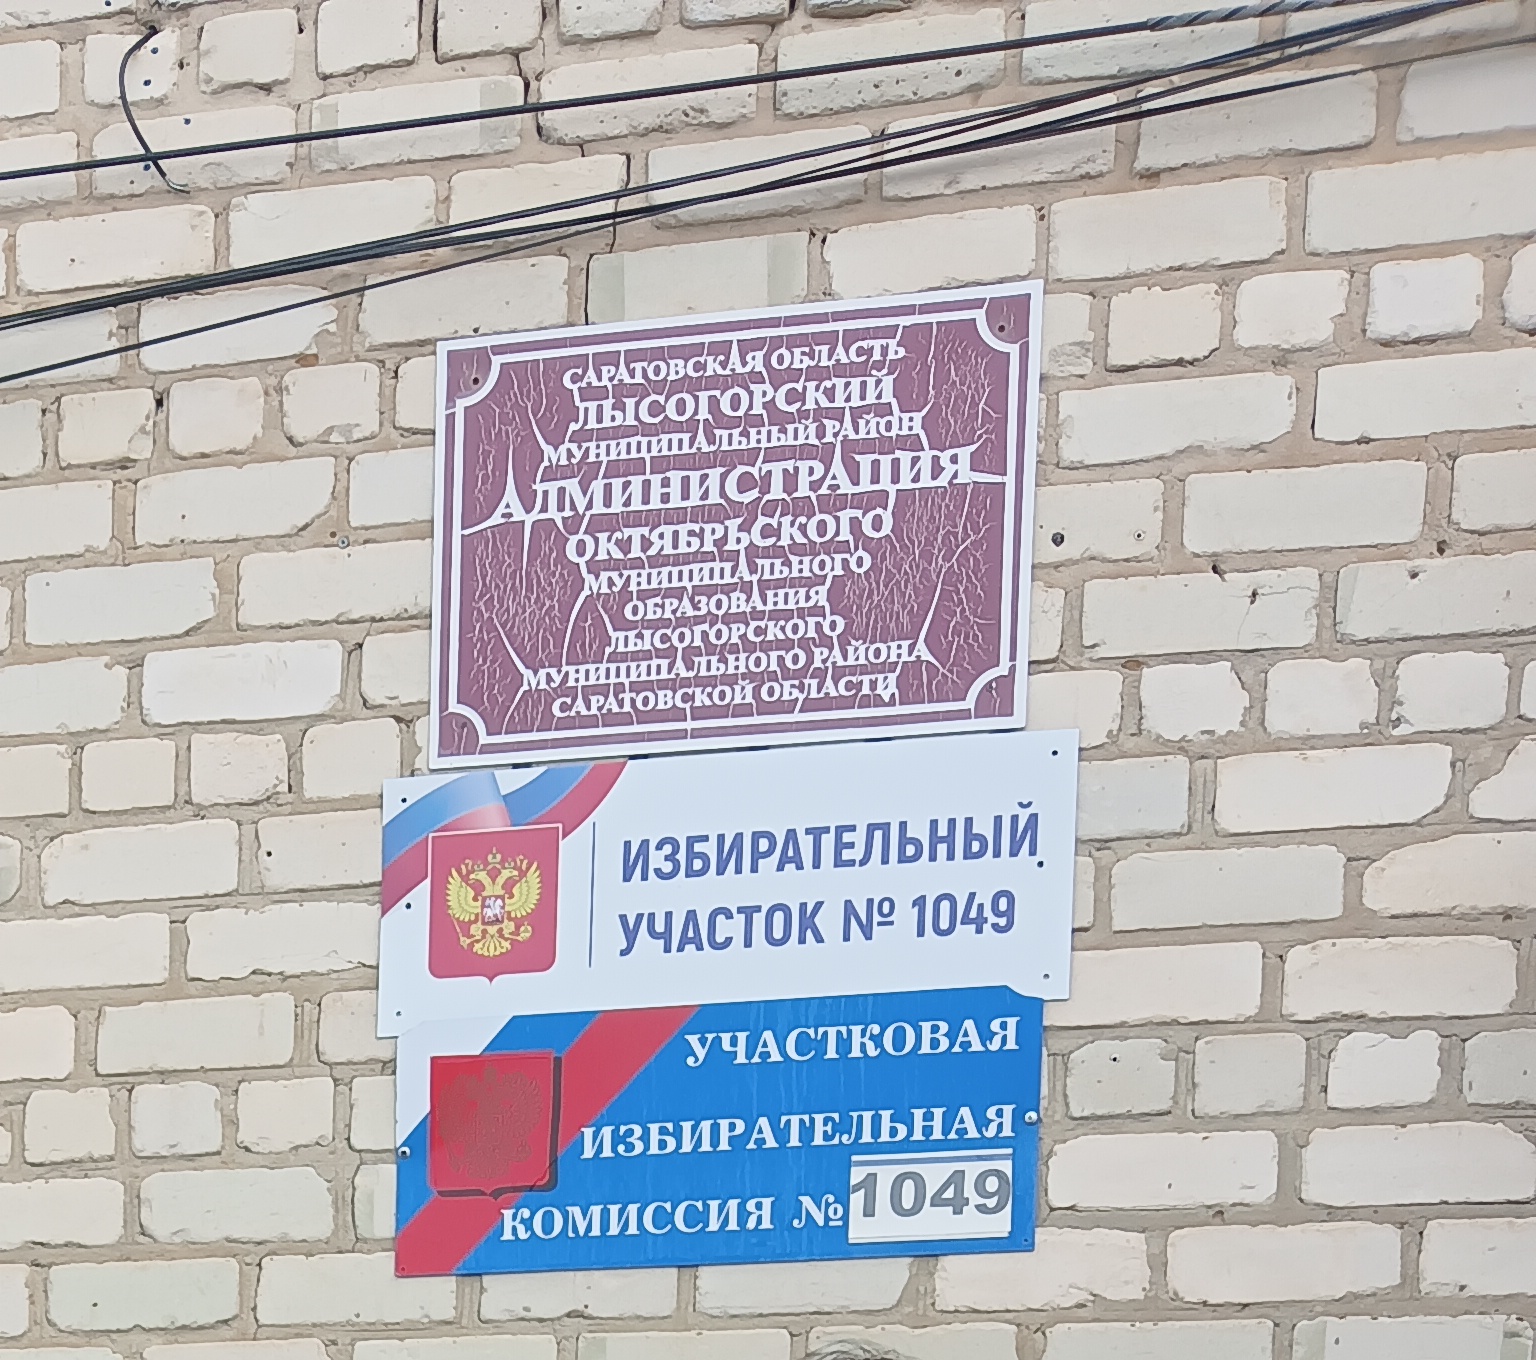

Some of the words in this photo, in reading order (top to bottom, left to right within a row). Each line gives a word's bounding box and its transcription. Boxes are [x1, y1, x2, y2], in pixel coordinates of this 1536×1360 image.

[562, 347, 765, 390] САРАТОВСКАЯ
[770, 339, 906, 370] ОБЛАСТЬ
[570, 370, 897, 430] ЛЫСОГОРСКИЙ
[543, 418, 820, 466] МУНИЦИПАЛЬНЫЙ
[822, 412, 922, 444] РАЙОН
[484, 446, 973, 521] АДМИНИСТРАЦИЯ
[565, 508, 894, 564] ОКТЯБРЬСКОГО
[583, 550, 872, 595] МУНИЦИПАЛЬНОГО
[623, 585, 828, 622] ОБРАЗОВАНИЯ
[607, 614, 845, 653] ЛЫСОГОРСКОГО
[522, 647, 807, 691] МУНИЦИПАЛЬНОГО
[813, 637, 931, 668] РАЙОНА
[551, 679, 755, 718] САРАТОВСКОЙ
[760, 672, 899, 703] ОБЛАСТИ
[621, 800, 1041, 883] ИЗБИРАТЕЛЬНЫЙ
[618, 900, 825, 957] УЧАСТОК
[841, 896, 897, 942] №
[911, 889, 1017, 938] 1049
[684, 1015, 1021, 1068] УЧАСТКОВАЯ
[579, 1103, 1018, 1160] ИЗБИРАТЕЛЬНАЯ
[499, 1196, 776, 1242] КОМИССИЯ
[792, 1193, 844, 1229] №
[850, 1167, 1011, 1219] 1049
